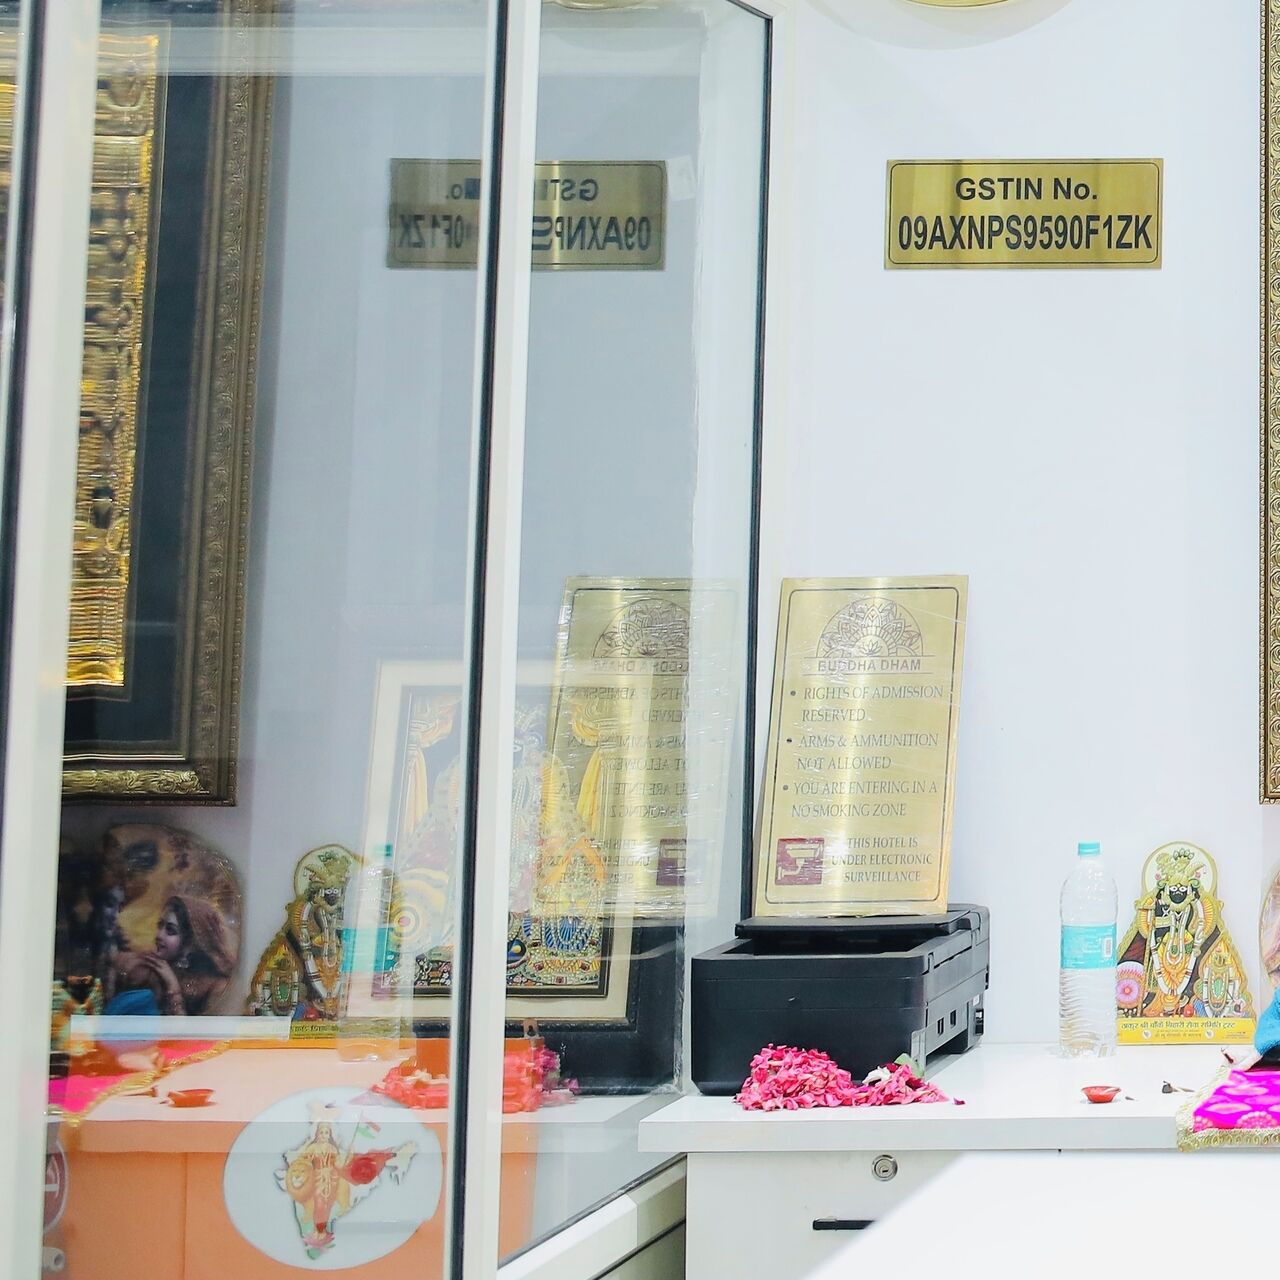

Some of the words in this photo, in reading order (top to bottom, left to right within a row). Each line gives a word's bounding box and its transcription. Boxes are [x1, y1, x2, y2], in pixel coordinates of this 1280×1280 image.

[955, 177, 1042, 200] GSTIN
[1053, 177, 1098, 200] No.
[898, 215, 1153, 250] 09AXNPS9590F1ZK
[881, 659, 921, 671] DHAM
[804, 687, 849, 700] RIGHTS
[852, 686, 869, 699] OF
[872, 685, 944, 699] ADMISSION
[802, 708, 866, 722] RESERVED
[799, 735, 835, 748] ARMS
[838, 735, 847, 747] &
[850, 733, 939, 747] AMMUNITION
[797, 758, 825, 770] NOT
[827, 756, 892, 770] ALLOWED
[794, 782, 819, 795] YOU
[822, 782, 845, 795] ARE
[849, 781, 910, 795] ENTERING
[912, 780, 926, 793] IN
[929, 781, 938, 793] A
[792, 805, 810, 818] NO
[813, 803, 870, 818] SMOKING
[872, 803, 907, 816] ZONE
[847, 837, 870, 849] THIS
[872, 836, 907, 849] HOTEL
[909, 836, 919, 848] IS
[831, 854, 867, 866] UNDER
[869, 853, 933, 865] ELECTRONIC
[844, 870, 921, 883] SURVEILLANCE
